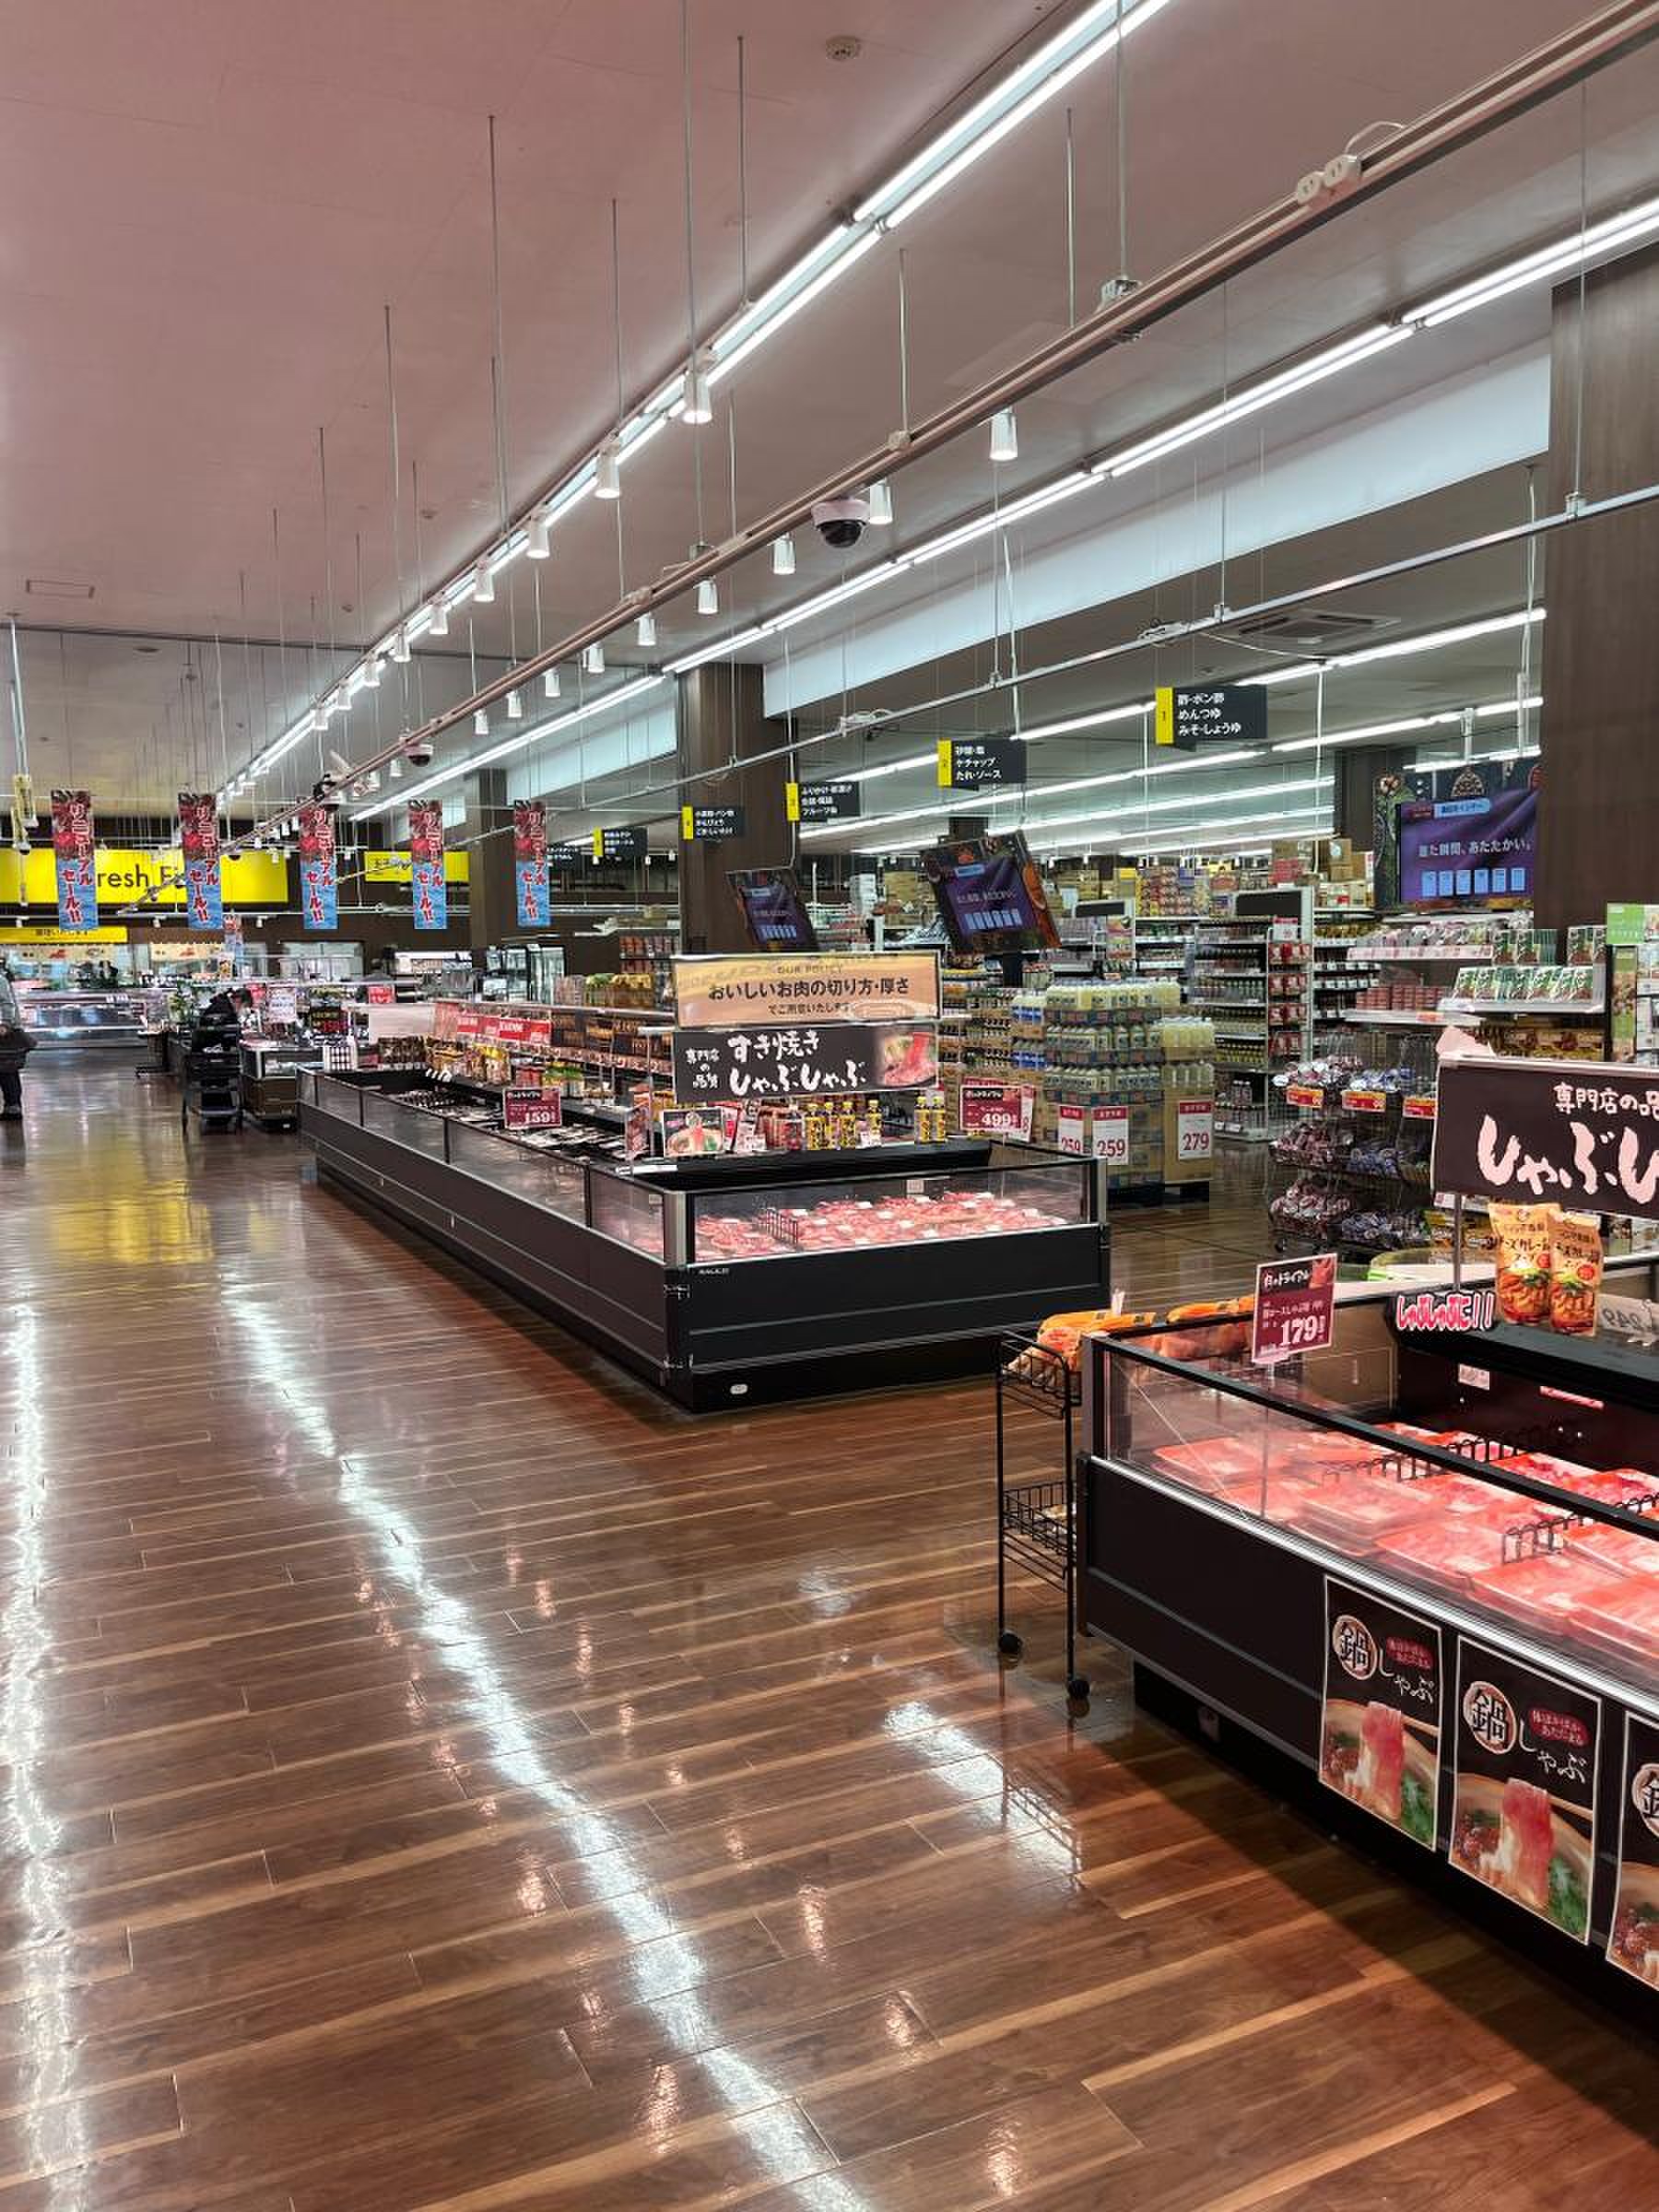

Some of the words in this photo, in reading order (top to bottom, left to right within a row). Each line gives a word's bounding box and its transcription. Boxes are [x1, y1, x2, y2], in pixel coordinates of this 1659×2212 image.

[1179, 708, 1221, 721] めんつゆ
[957, 757, 996, 768] ケチャップ
[777, 966, 800, 974] OUR
[806, 964, 842, 973] POLICY
[709, 977, 909, 1000] おいしいお肉の切り方・厚さ
[727, 1030, 819, 1063] すき焼き
[729, 1060, 866, 1095] しゃぶしゃぶ
[1097, 1139, 1126, 1158] 259
[1182, 1133, 1209, 1151] 279
[1280, 1315, 1318, 1346] 179
[1338, 1621, 1370, 1673] 鍋
[1471, 1688, 1507, 1742] 鍋
